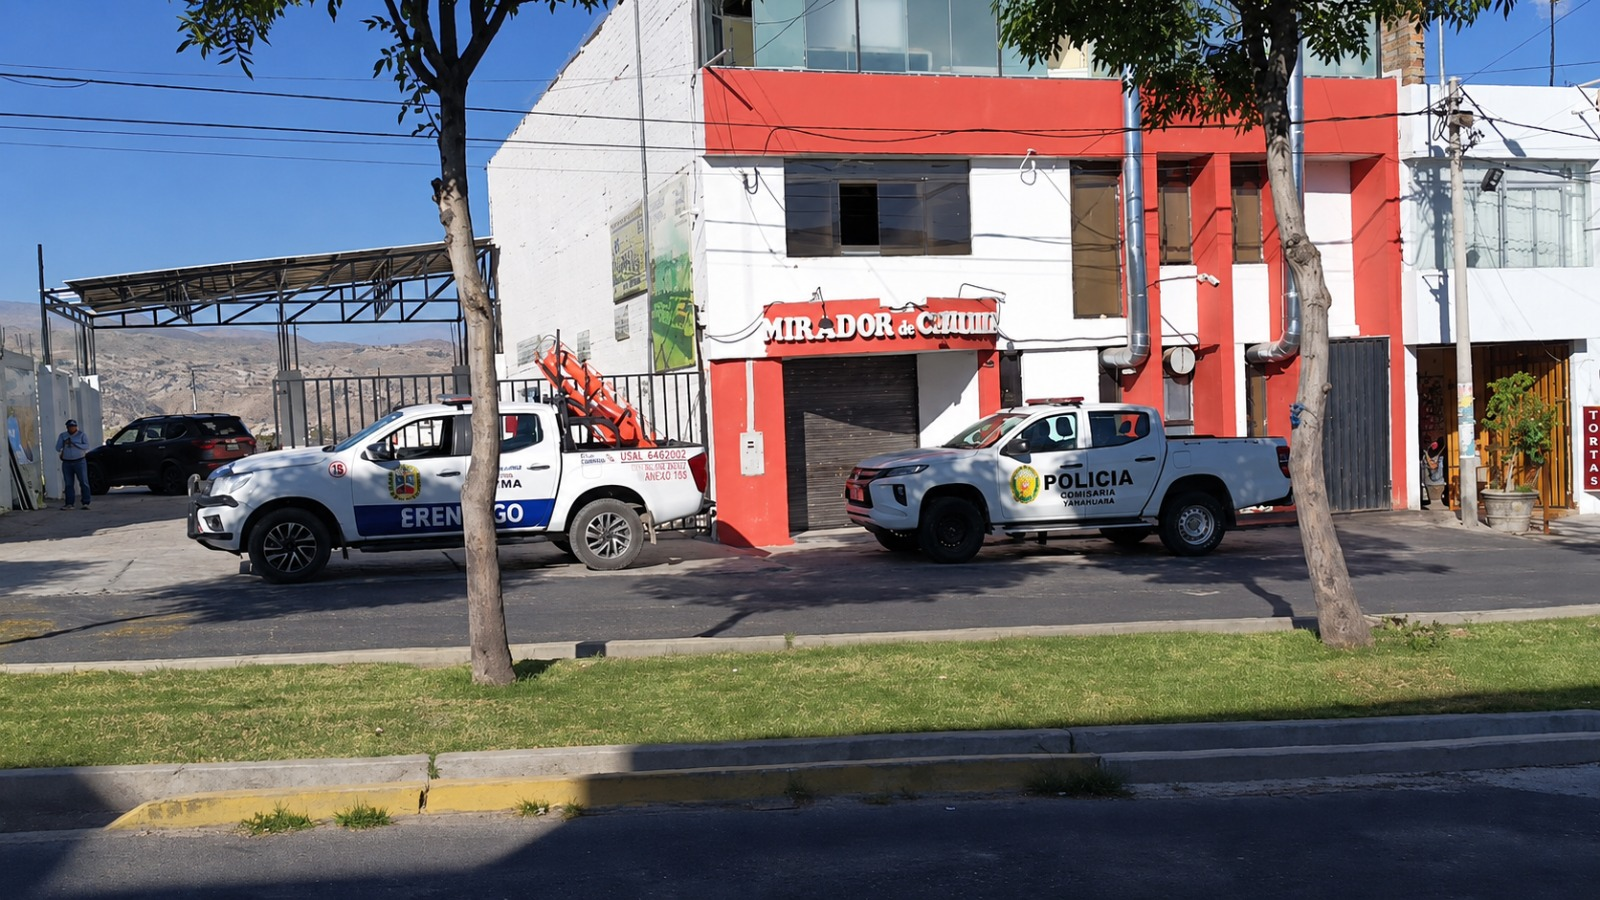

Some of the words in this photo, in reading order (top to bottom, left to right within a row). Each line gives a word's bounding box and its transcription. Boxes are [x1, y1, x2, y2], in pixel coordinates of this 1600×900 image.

[764, 312, 895, 341] MIRADOR
[898, 319, 915, 336] de
[1588, 410, 1599, 485] TORTAS
[1044, 469, 1134, 490] POLICIA
[1060, 489, 1115, 499] COMISARIA
